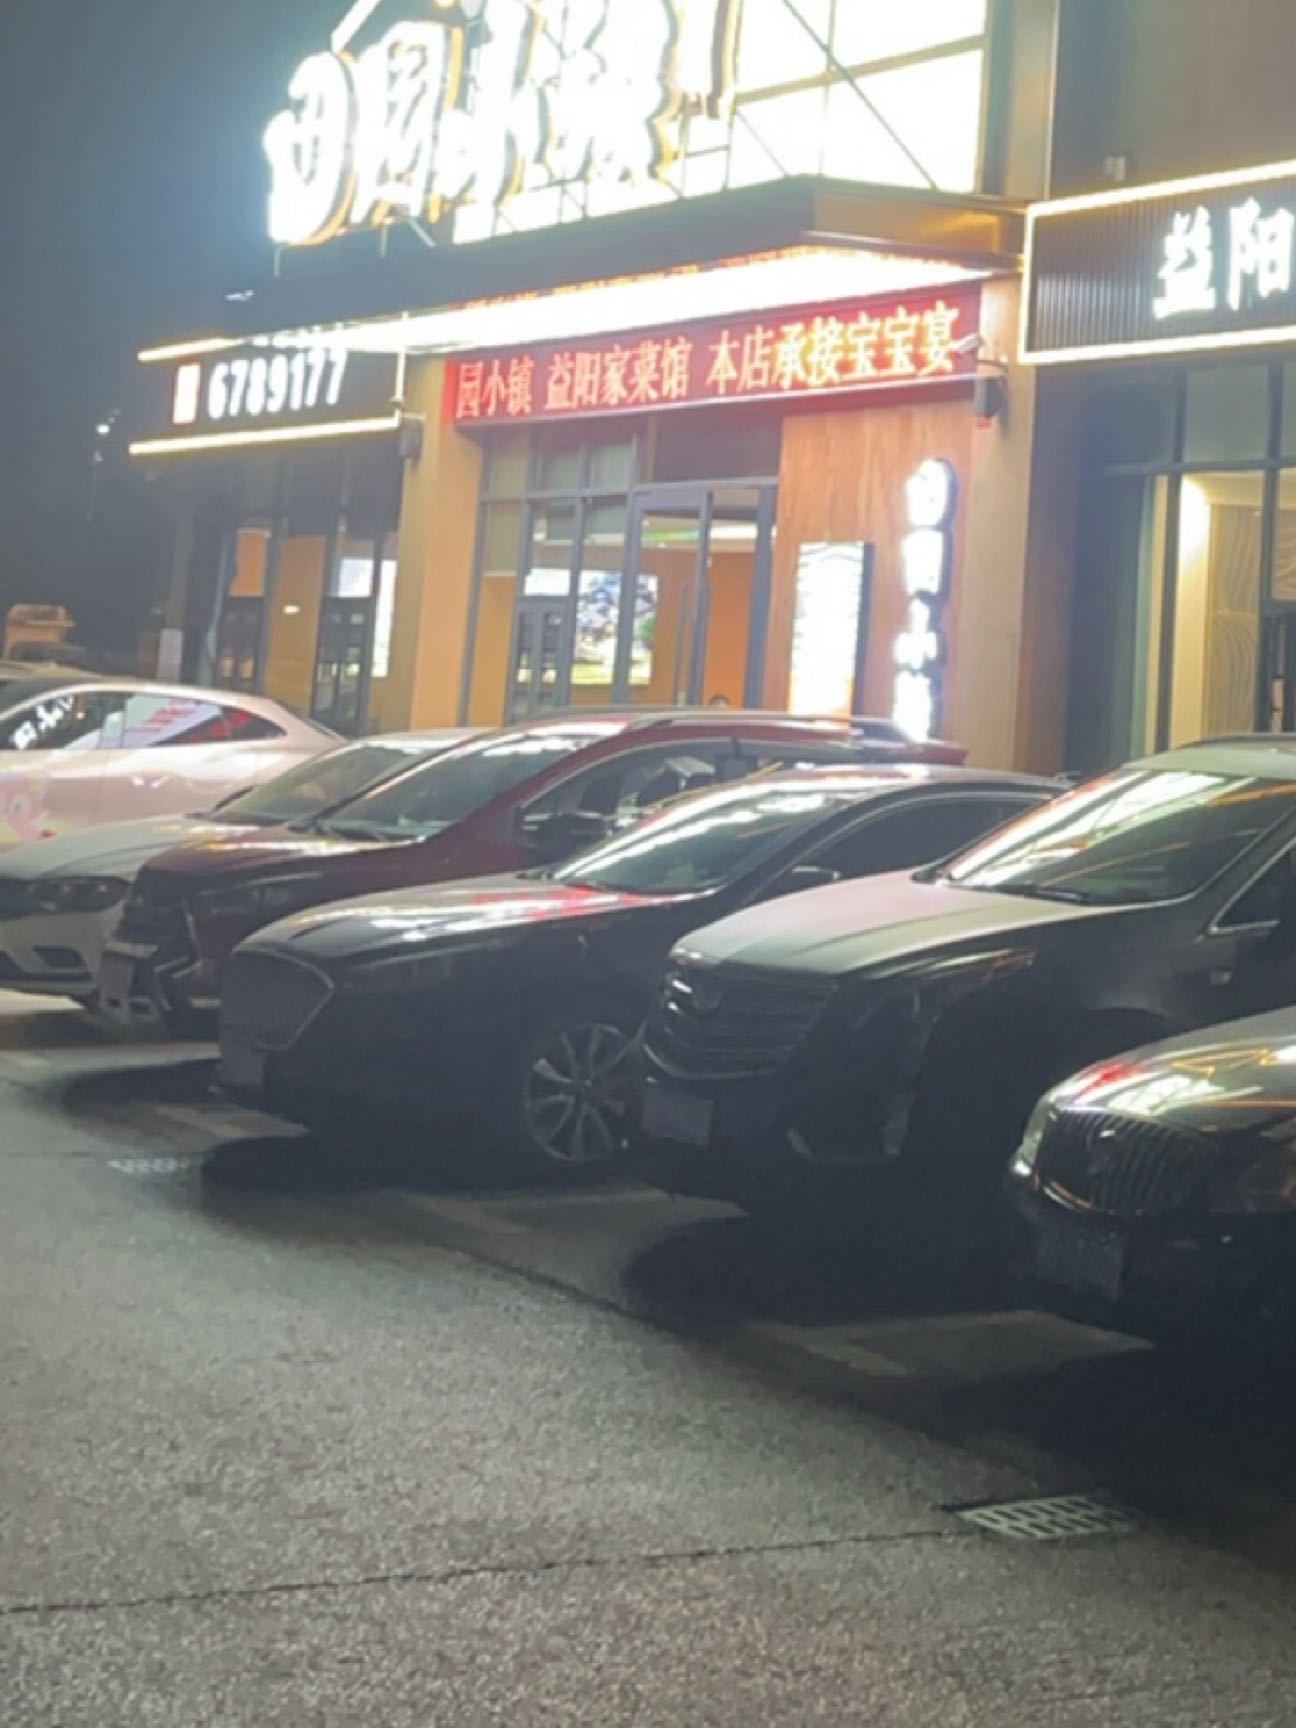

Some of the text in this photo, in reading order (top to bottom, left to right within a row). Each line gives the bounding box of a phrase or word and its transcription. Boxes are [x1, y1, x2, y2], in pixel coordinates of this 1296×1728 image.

[207, 342, 349, 420] 6789177
[544, 335, 694, 412] 益阳家菜馆
[705, 299, 960, 396] 本店承接宝宝宴
